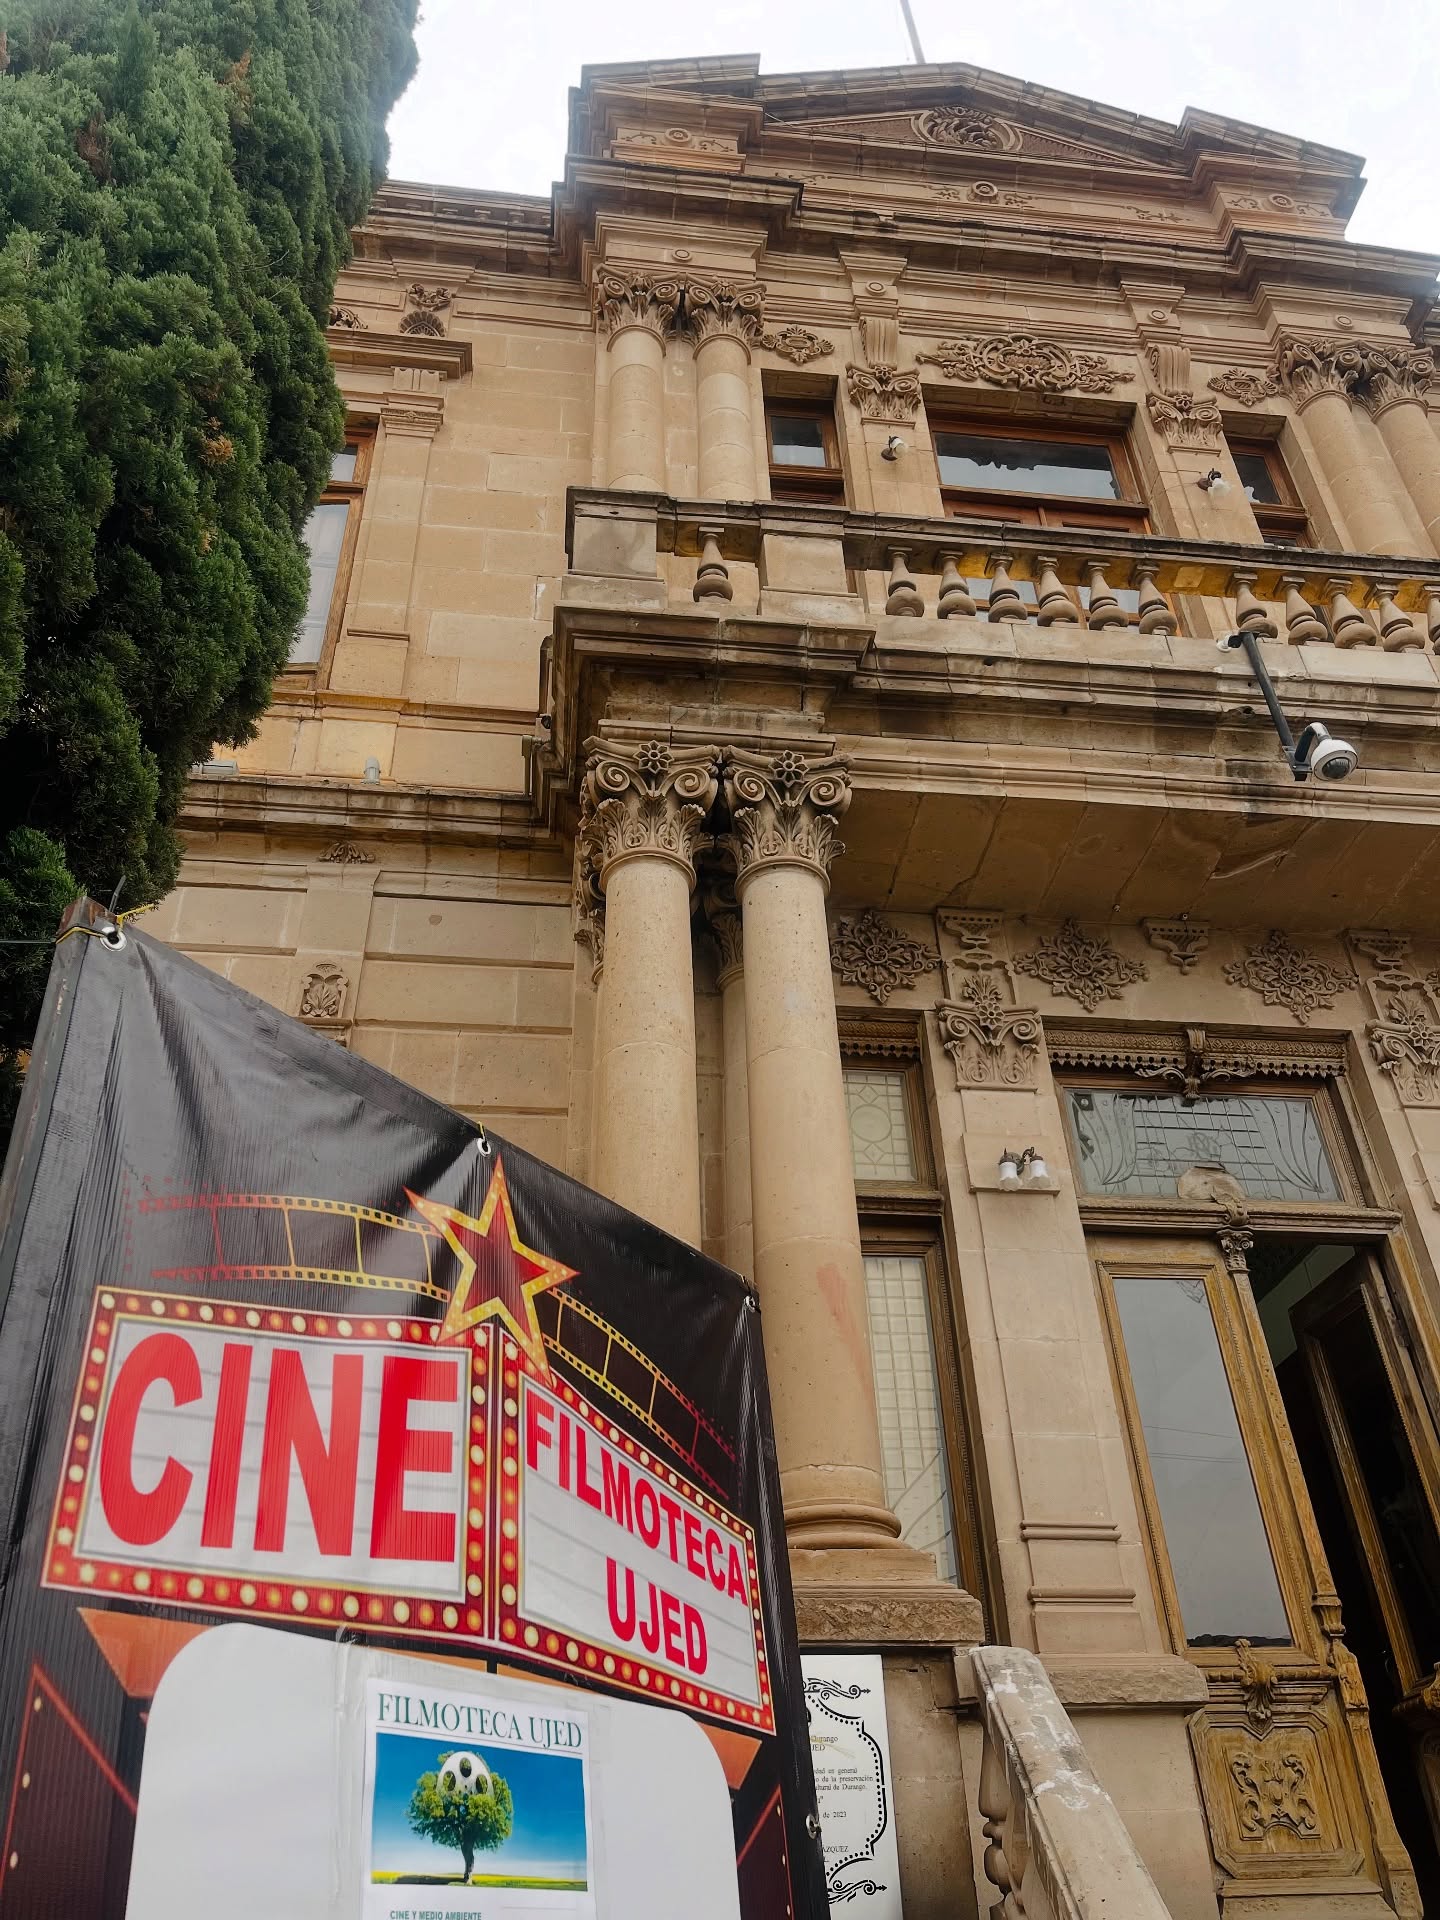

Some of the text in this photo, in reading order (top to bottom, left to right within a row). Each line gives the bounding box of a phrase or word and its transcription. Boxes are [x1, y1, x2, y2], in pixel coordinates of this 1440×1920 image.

[100, 1333, 459, 1562] CINE
[526, 1389, 748, 1606] FILMOTECA
[607, 1558, 708, 1676] UJED
[378, 1693, 582, 1748] FILMOTECA UJED
[822, 1811, 830, 1819] de
[390, 1910, 482, 1920] CINE Y MEDIO AMBIENTE
